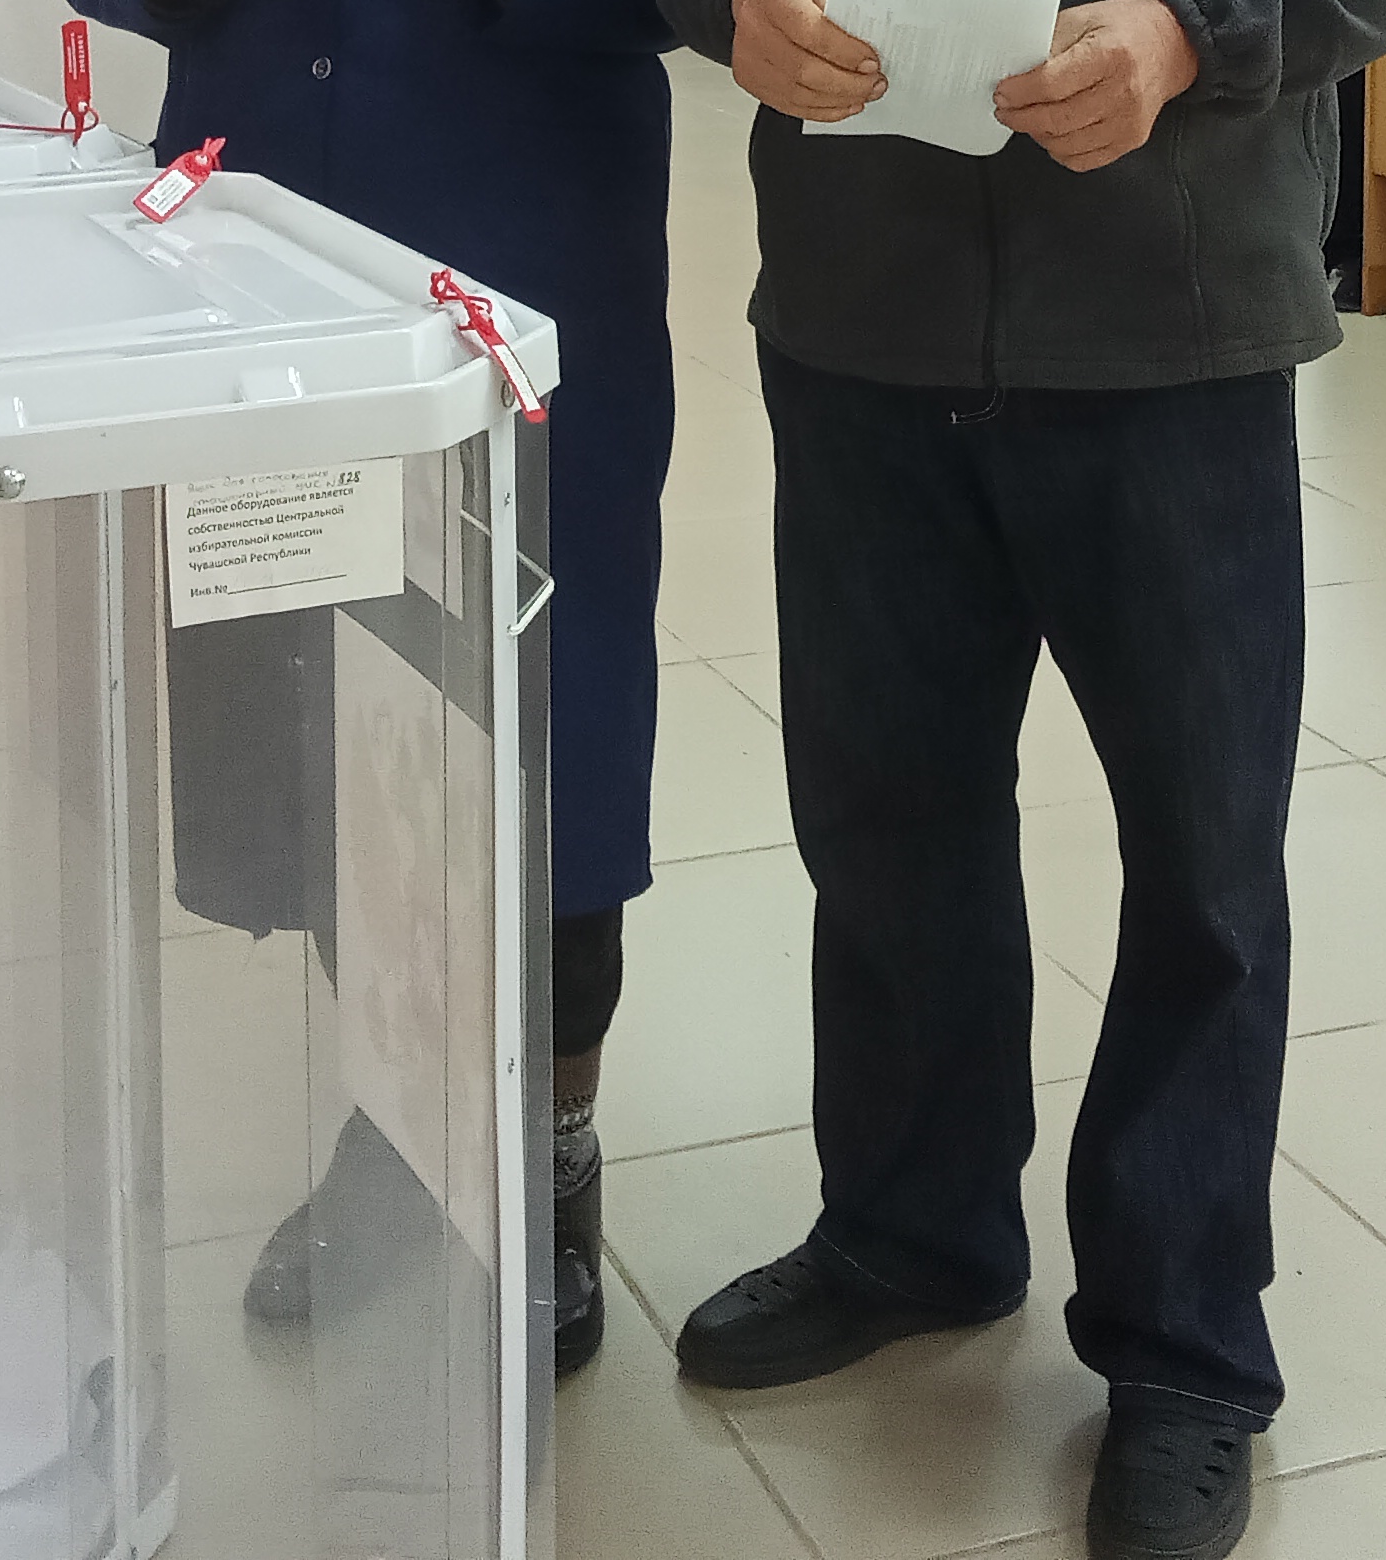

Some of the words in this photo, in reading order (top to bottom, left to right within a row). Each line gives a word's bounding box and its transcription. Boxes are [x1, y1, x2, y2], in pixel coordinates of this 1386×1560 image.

[186, 506, 229, 519] Данное
[230, 493, 307, 511] оборудование
[309, 486, 354, 500] является
[187, 516, 274, 535] собственностью
[276, 504, 345, 523] Центральной
[188, 533, 270, 553] избирательной
[272, 528, 323, 541] комиссии
[188, 554, 248, 572] Чувашской
[250, 547, 311, 562] Республики
